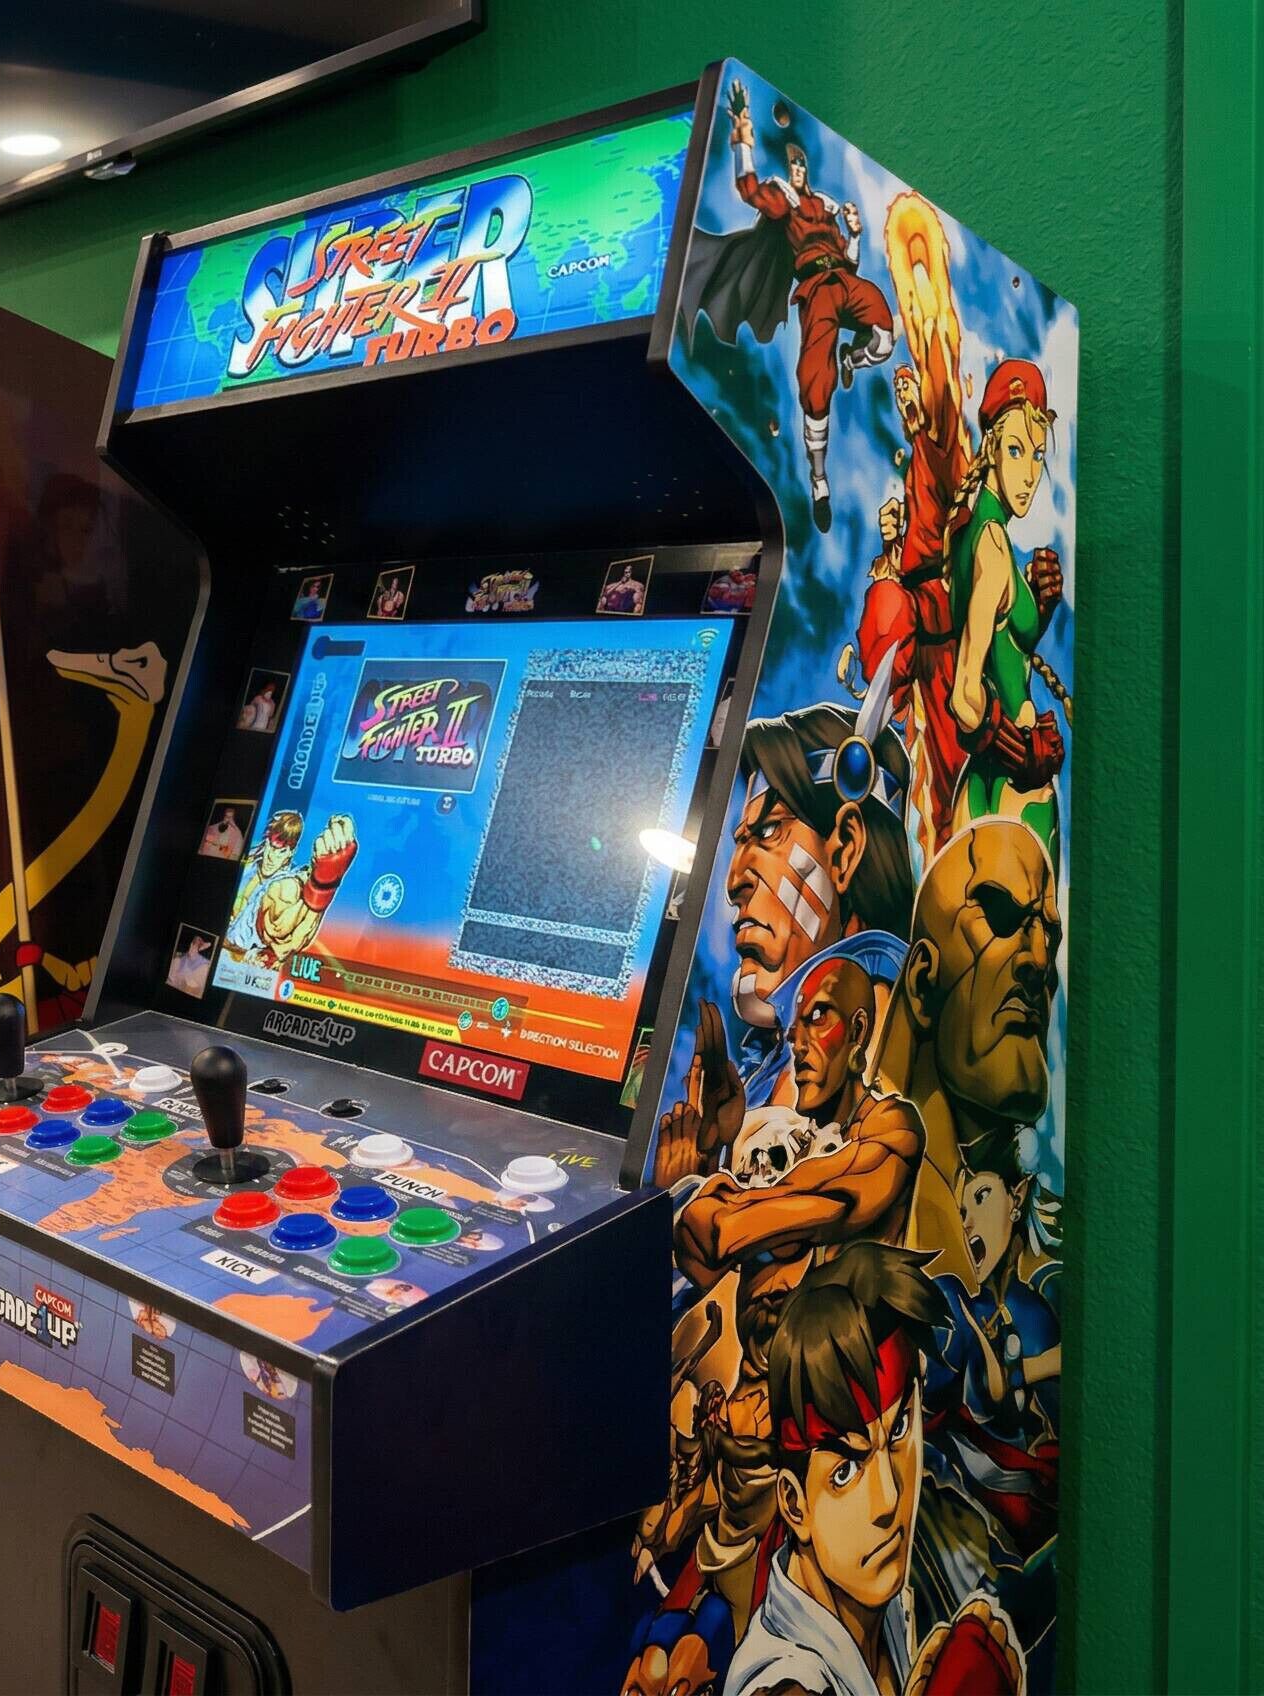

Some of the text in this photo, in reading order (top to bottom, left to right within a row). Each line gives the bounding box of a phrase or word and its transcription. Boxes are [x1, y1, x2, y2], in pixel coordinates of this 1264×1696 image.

[287, 203, 462, 297] STREET
[547, 254, 610, 278] CAPCOM
[245, 279, 439, 369] FIGHTER
[363, 309, 503, 366] TURBO
[360, 678, 459, 731] STREET
[359, 705, 441, 761] FIGHTER
[416, 745, 475, 768] TURBO
[427, 1049, 516, 1090] CAPCOM
[215, 1255, 262, 1278] KICK
[35, 1288, 73, 1318] CAPCOM
